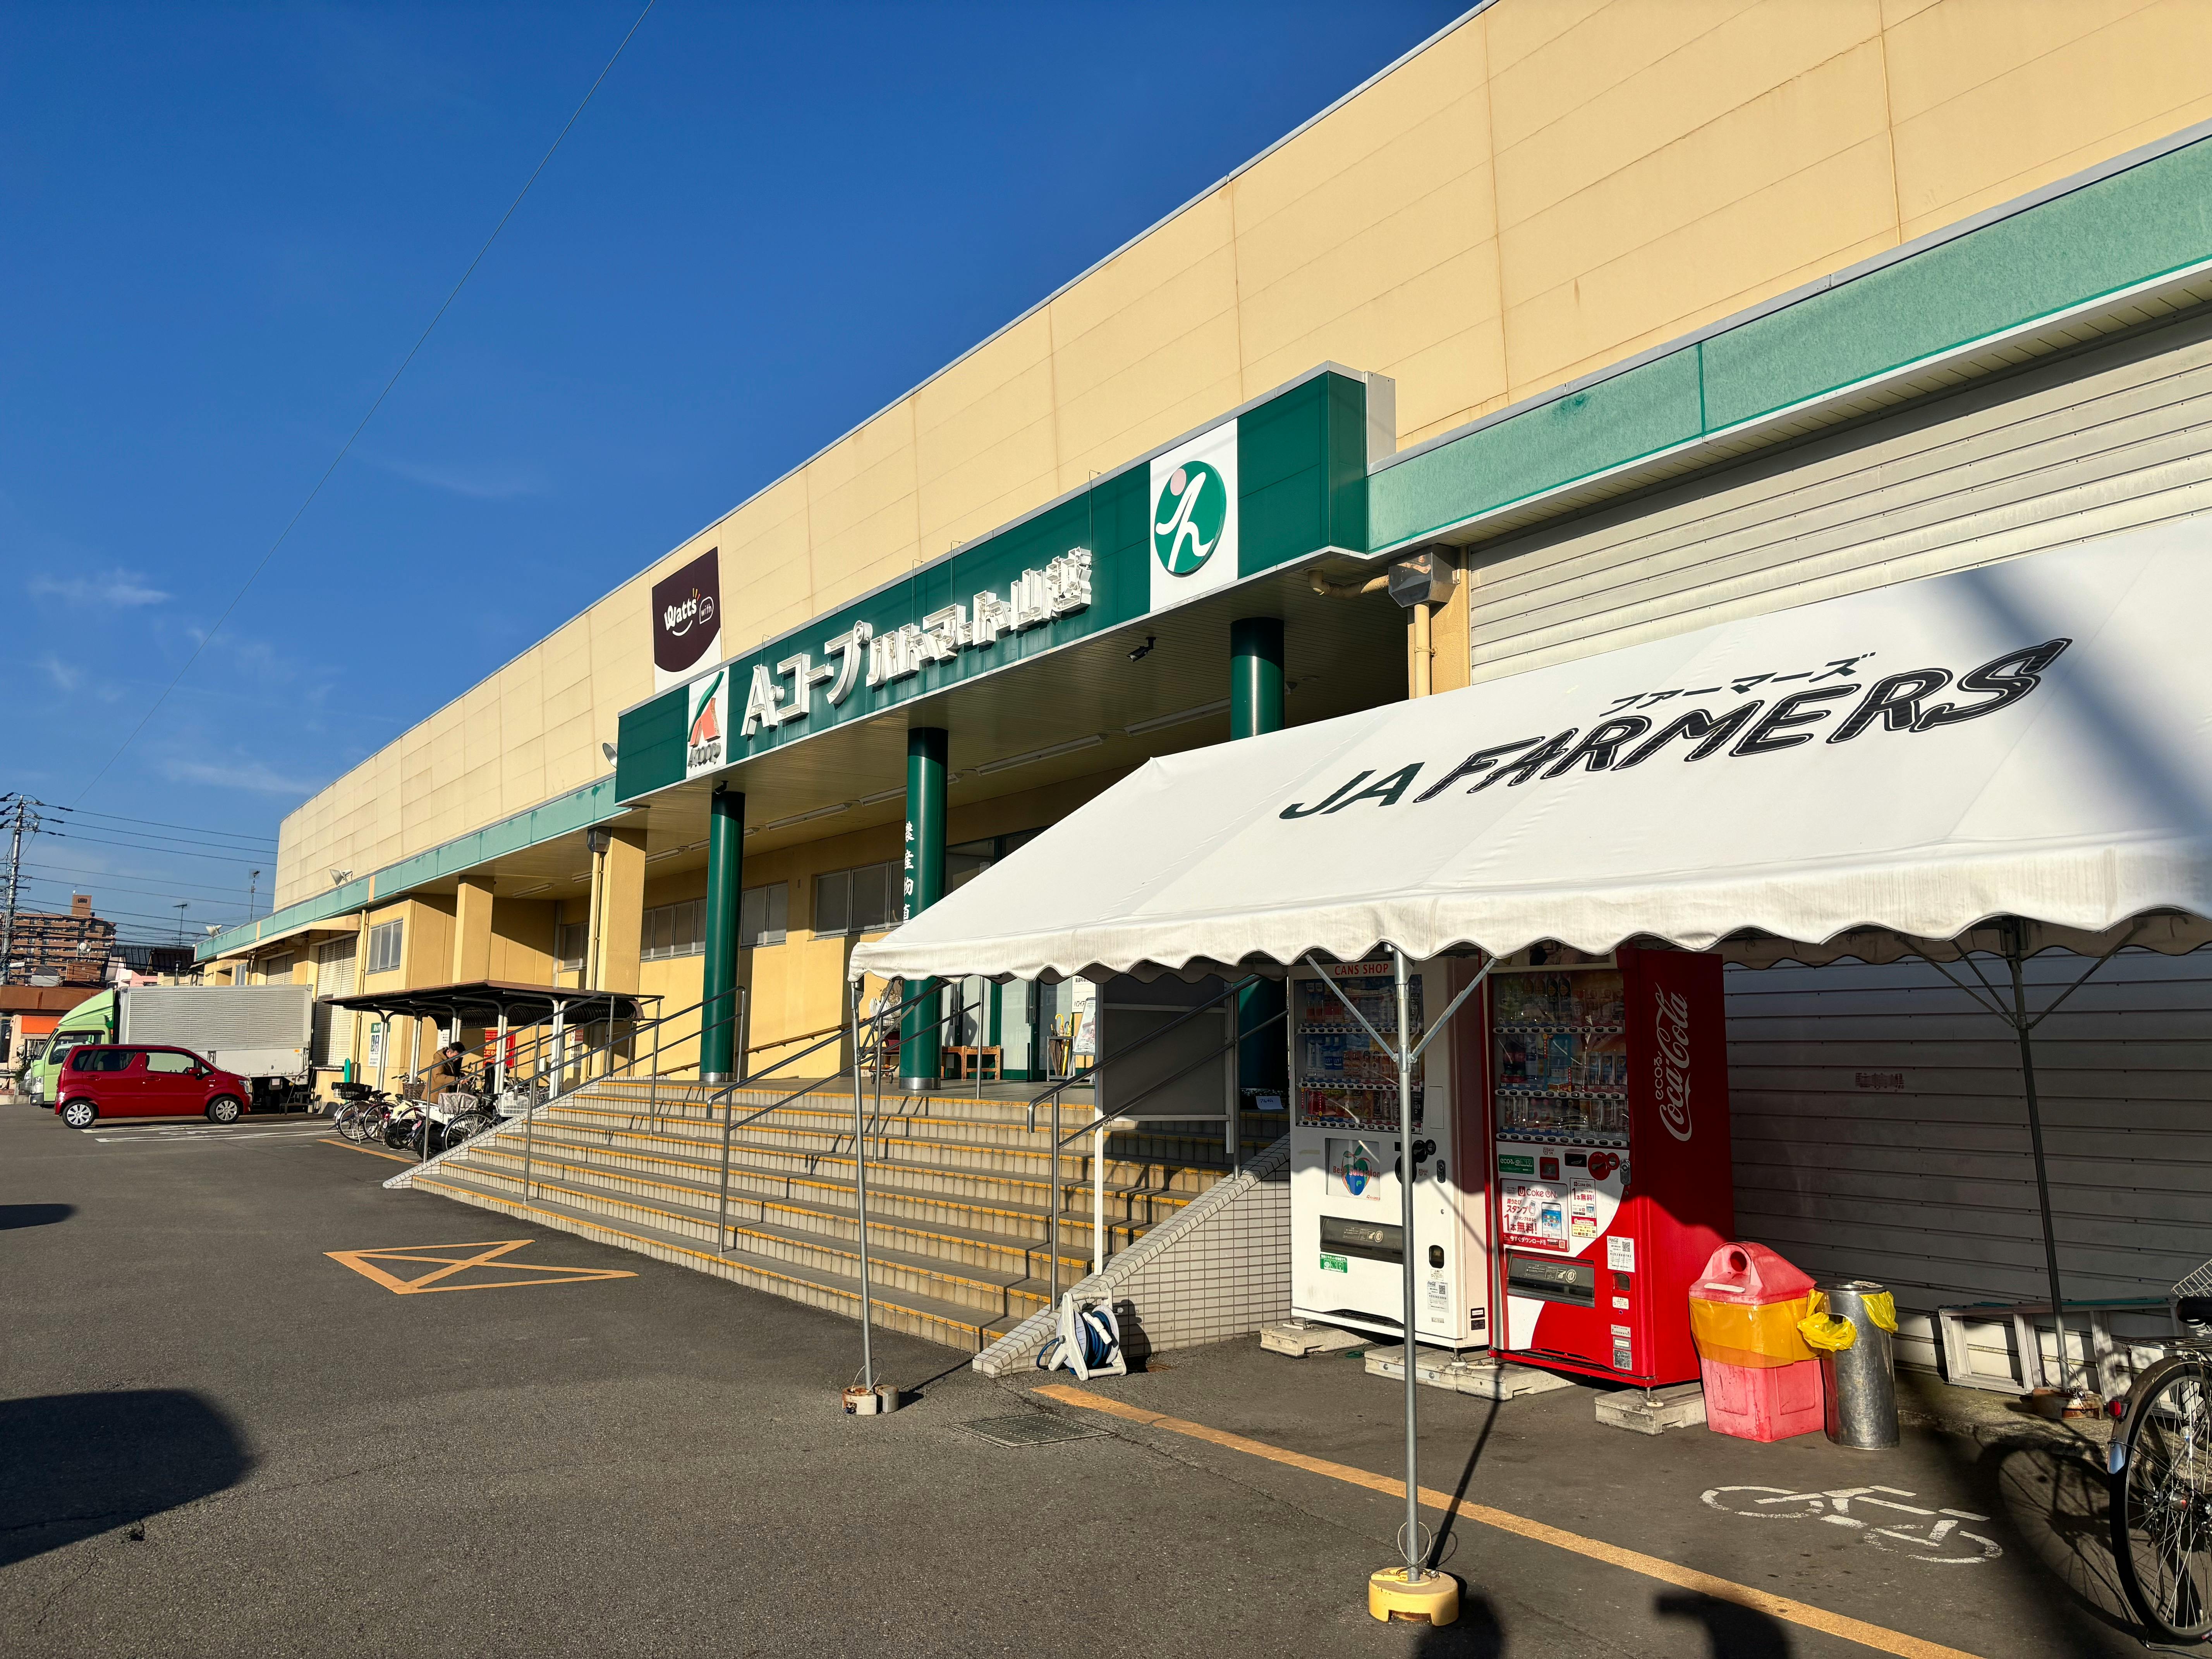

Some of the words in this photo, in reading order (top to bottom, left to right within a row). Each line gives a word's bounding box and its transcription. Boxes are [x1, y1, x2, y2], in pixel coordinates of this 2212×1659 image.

[664, 598, 697, 630] Watts
[701, 603, 712, 617] with
[1599, 651, 1877, 717] ファーマーズ
[1279, 761, 1425, 820] JA
[1413, 637, 2073, 804] FARMERS
[1334, 965, 1359, 975] CANS
[1363, 963, 1388, 974] SHOP
[1655, 982, 1692, 1141] Coca-Cola
[1526, 1188, 1544, 1197] Coke
[1506, 1205, 1528, 1214] スタンプ
